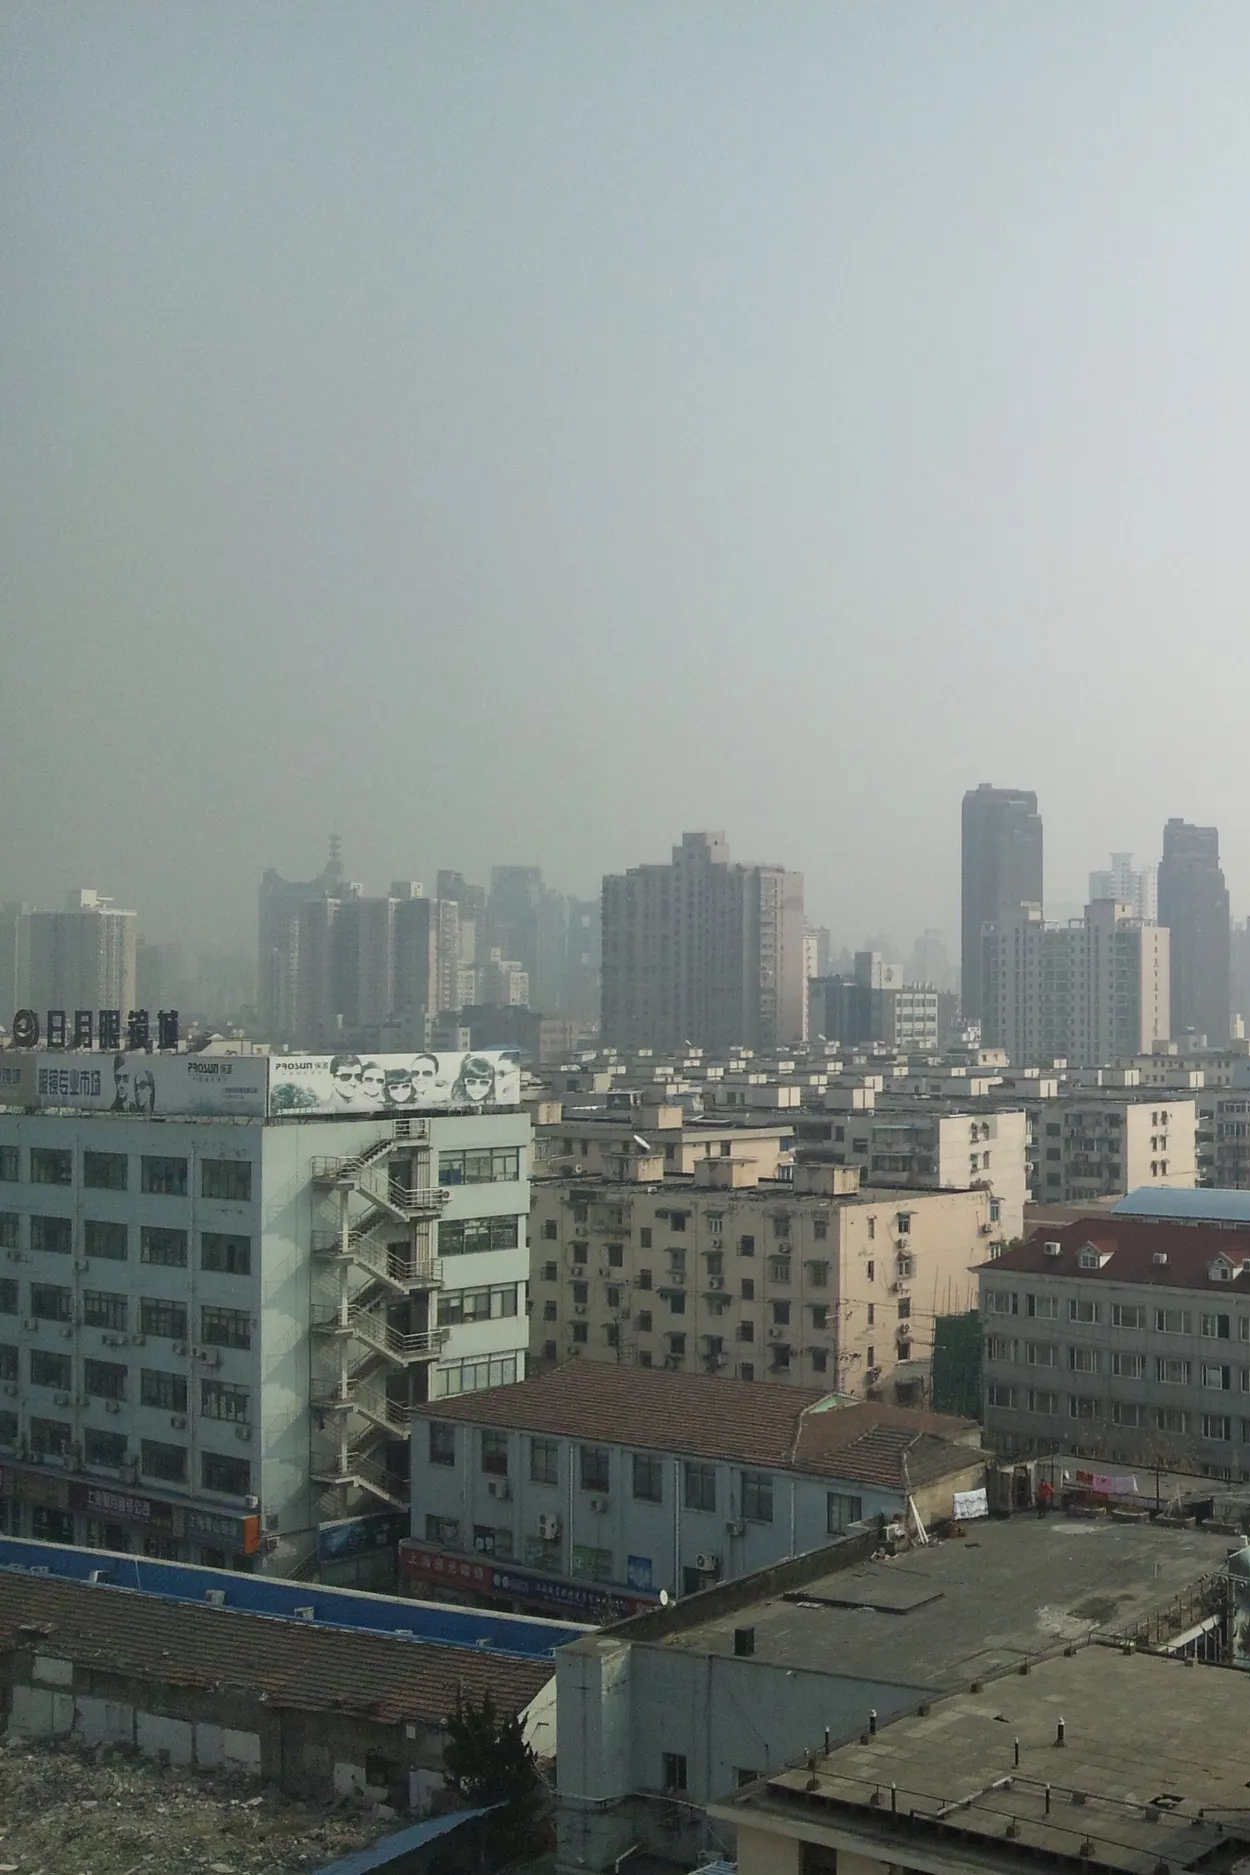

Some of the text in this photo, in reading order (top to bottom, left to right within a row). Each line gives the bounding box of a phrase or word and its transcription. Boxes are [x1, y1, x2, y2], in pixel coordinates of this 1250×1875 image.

[187, 1062, 219, 1074] PROSUN
[275, 1062, 313, 1071] PROSUN
[38, 1068, 101, 1096] 眼镜专业市场
